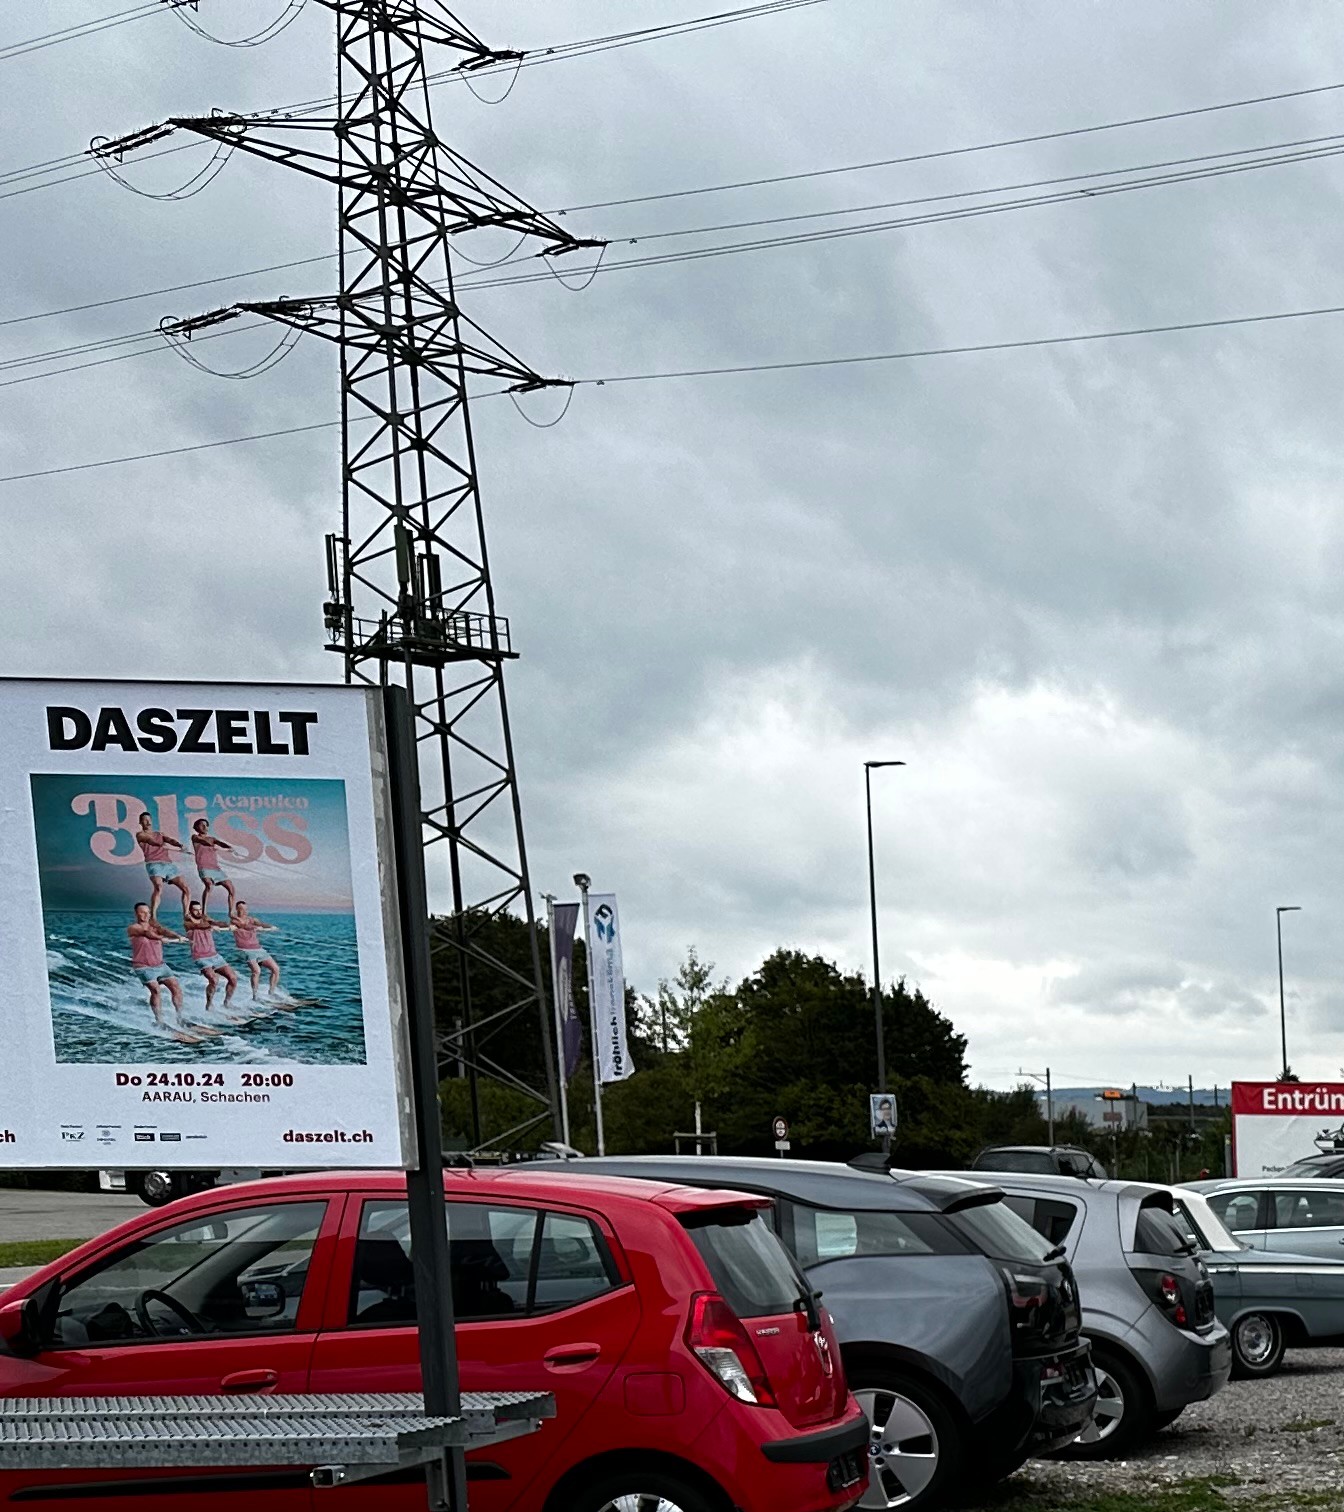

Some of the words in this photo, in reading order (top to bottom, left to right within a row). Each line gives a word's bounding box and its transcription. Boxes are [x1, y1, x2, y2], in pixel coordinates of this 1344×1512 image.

[46, 706, 318, 755] DASZELT
[211, 794, 309, 812] Acapulco
[71, 793, 312, 865] Bliss
[116, 1073, 142, 1087] Do
[147, 1073, 224, 1087] 24.10.24
[241, 1073, 293, 1087] 20:00
[142, 1091, 196, 1104] AARAU,
[200, 1091, 271, 1103] Schachen
[283, 1130, 373, 1143] daszelt.ch
